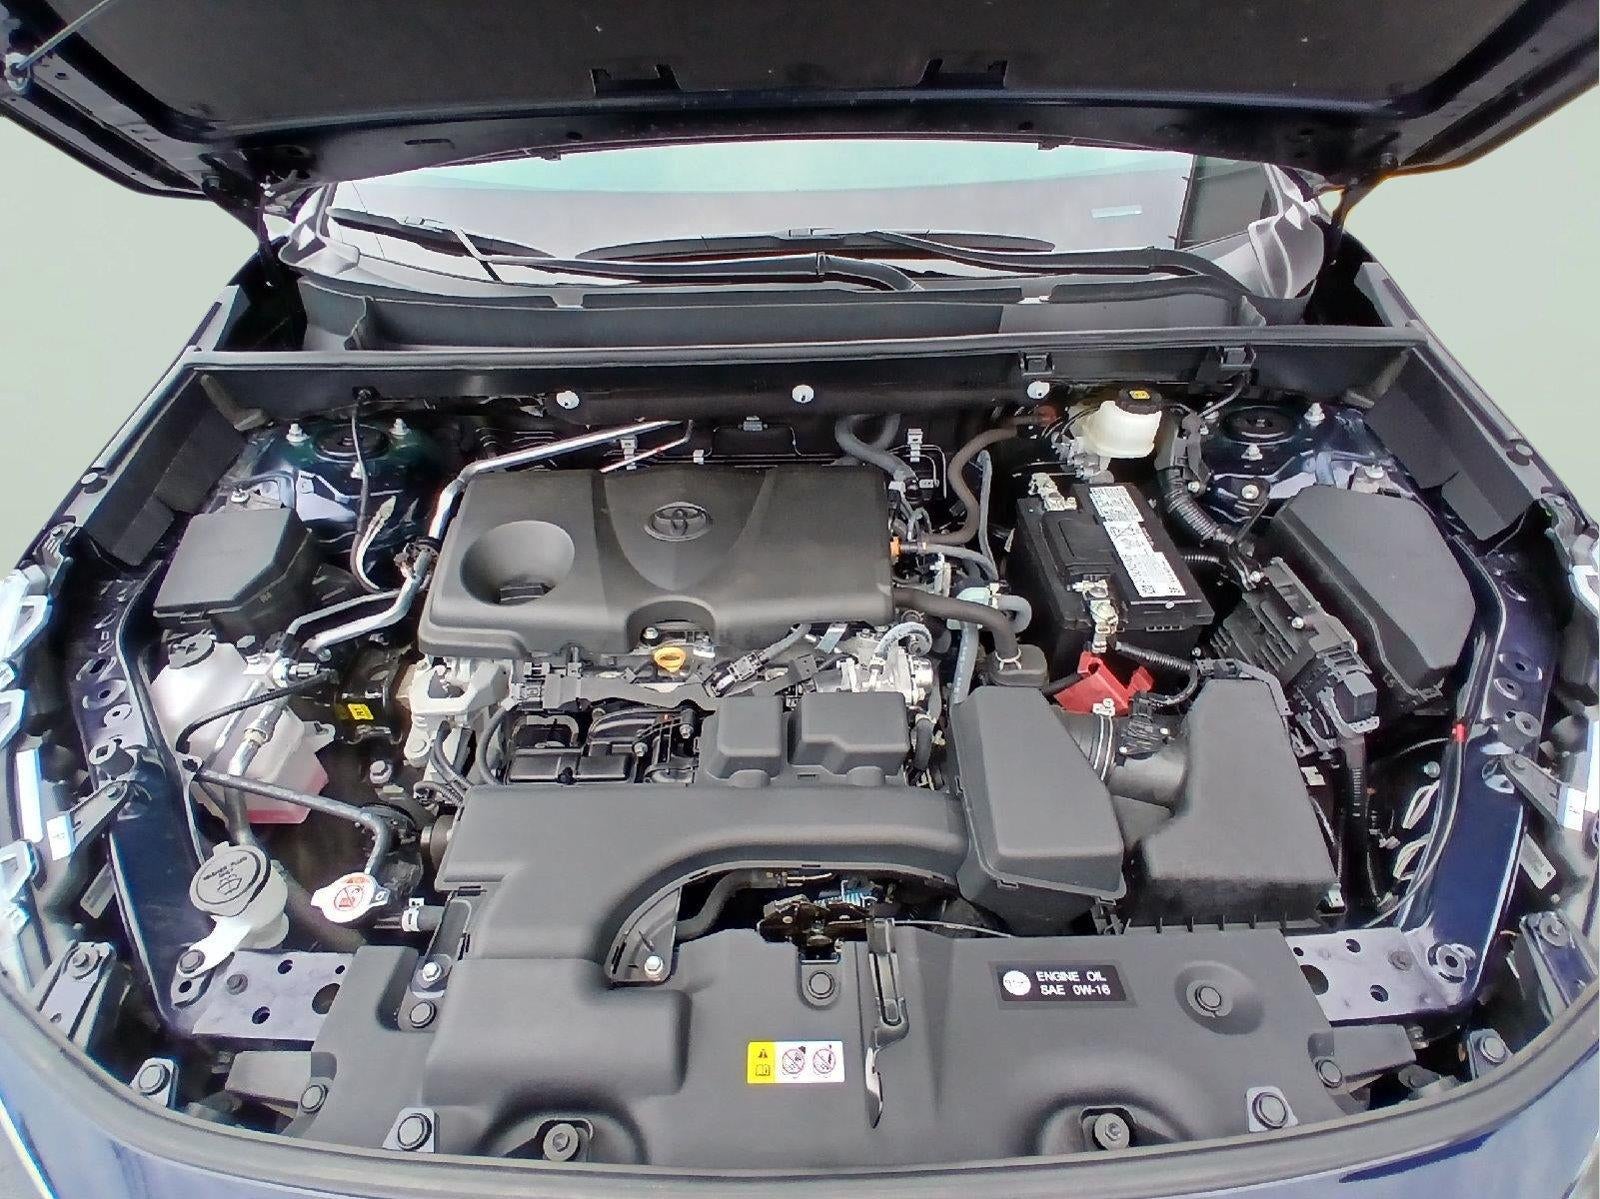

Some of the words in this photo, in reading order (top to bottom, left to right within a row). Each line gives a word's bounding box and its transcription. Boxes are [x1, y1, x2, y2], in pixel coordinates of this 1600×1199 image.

[1035, 971, 1080, 982] ENGINE
[1086, 971, 1107, 982] OIL
[1040, 984, 1066, 995] SAE
[1072, 984, 1111, 995] 0W-16
